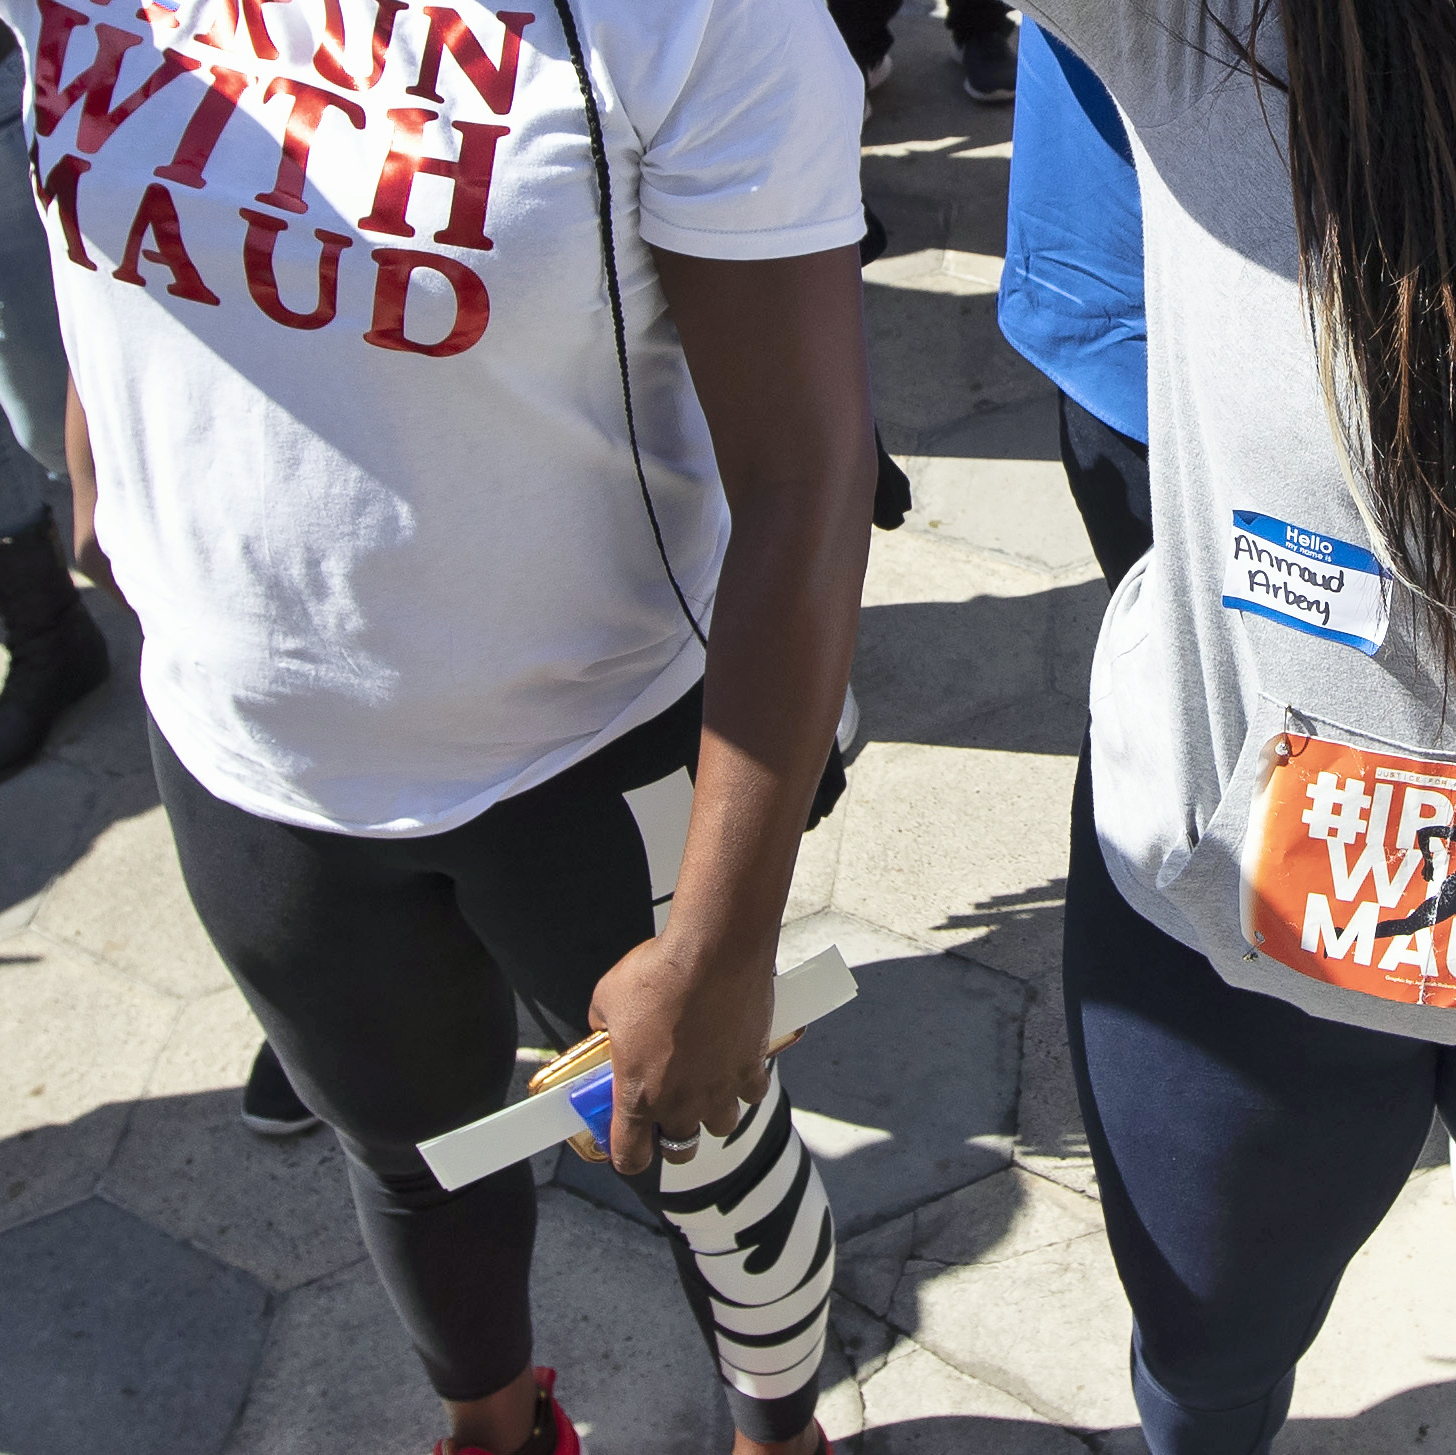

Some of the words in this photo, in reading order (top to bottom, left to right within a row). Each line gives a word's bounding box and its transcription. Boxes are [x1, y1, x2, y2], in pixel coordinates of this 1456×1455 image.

[1285, 541, 1298, 552] my
[1299, 547, 1323, 560] name
[1325, 554, 1333, 563] is
[1286, 525, 1333, 554] Hello
[1234, 535, 1345, 593] Ahmaud
[1248, 570, 1331, 626] Arbery
[1377, 770, 1420, 783] JUSTICE
[1428, 777, 1447, 787] FOR
